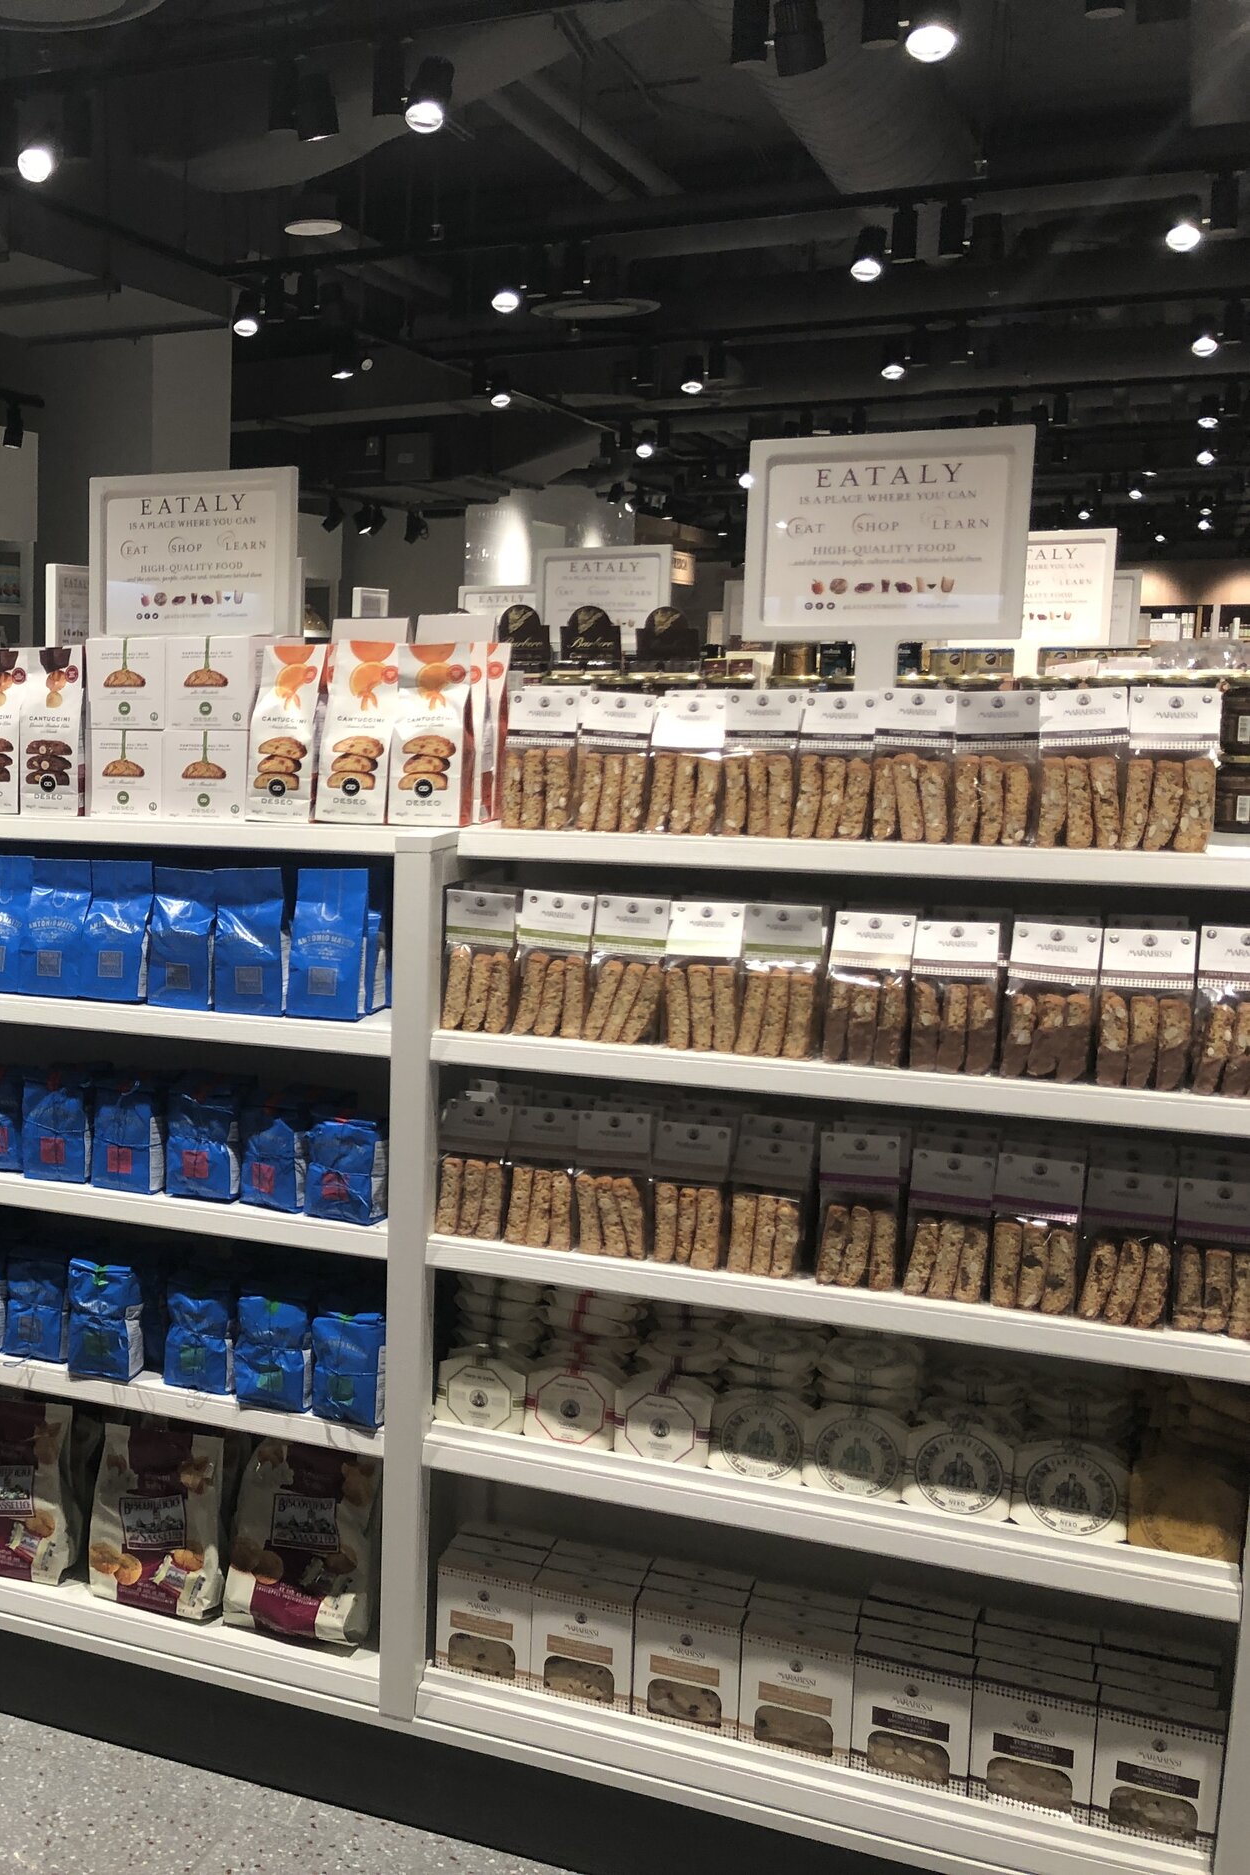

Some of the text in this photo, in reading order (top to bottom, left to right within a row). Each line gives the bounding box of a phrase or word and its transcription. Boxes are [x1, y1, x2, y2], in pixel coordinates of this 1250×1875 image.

[816, 463, 964, 488] EATALY
[800, 489, 976, 504] IS A PLACE WHERE YOU CAN
[141, 493, 246, 516] EATALY
[129, 517, 256, 531] IS A PLACE WHERE YOU CAN
[795, 518, 989, 534] EAT SHOP LEARN
[126, 540, 266, 555] EAT SHOP LEARN
[813, 543, 956, 556] HIGH-QUALITY FOOD
[140, 562, 243, 574] HIGH-QUALITY FOOD
[570, 561, 642, 573] EATALY
[479, 595, 525, 604] EATALY
[261, 798, 293, 806] DESEO
[332, 798, 367, 806] DESEO
[298, 935, 330, 945] ANTONIO
